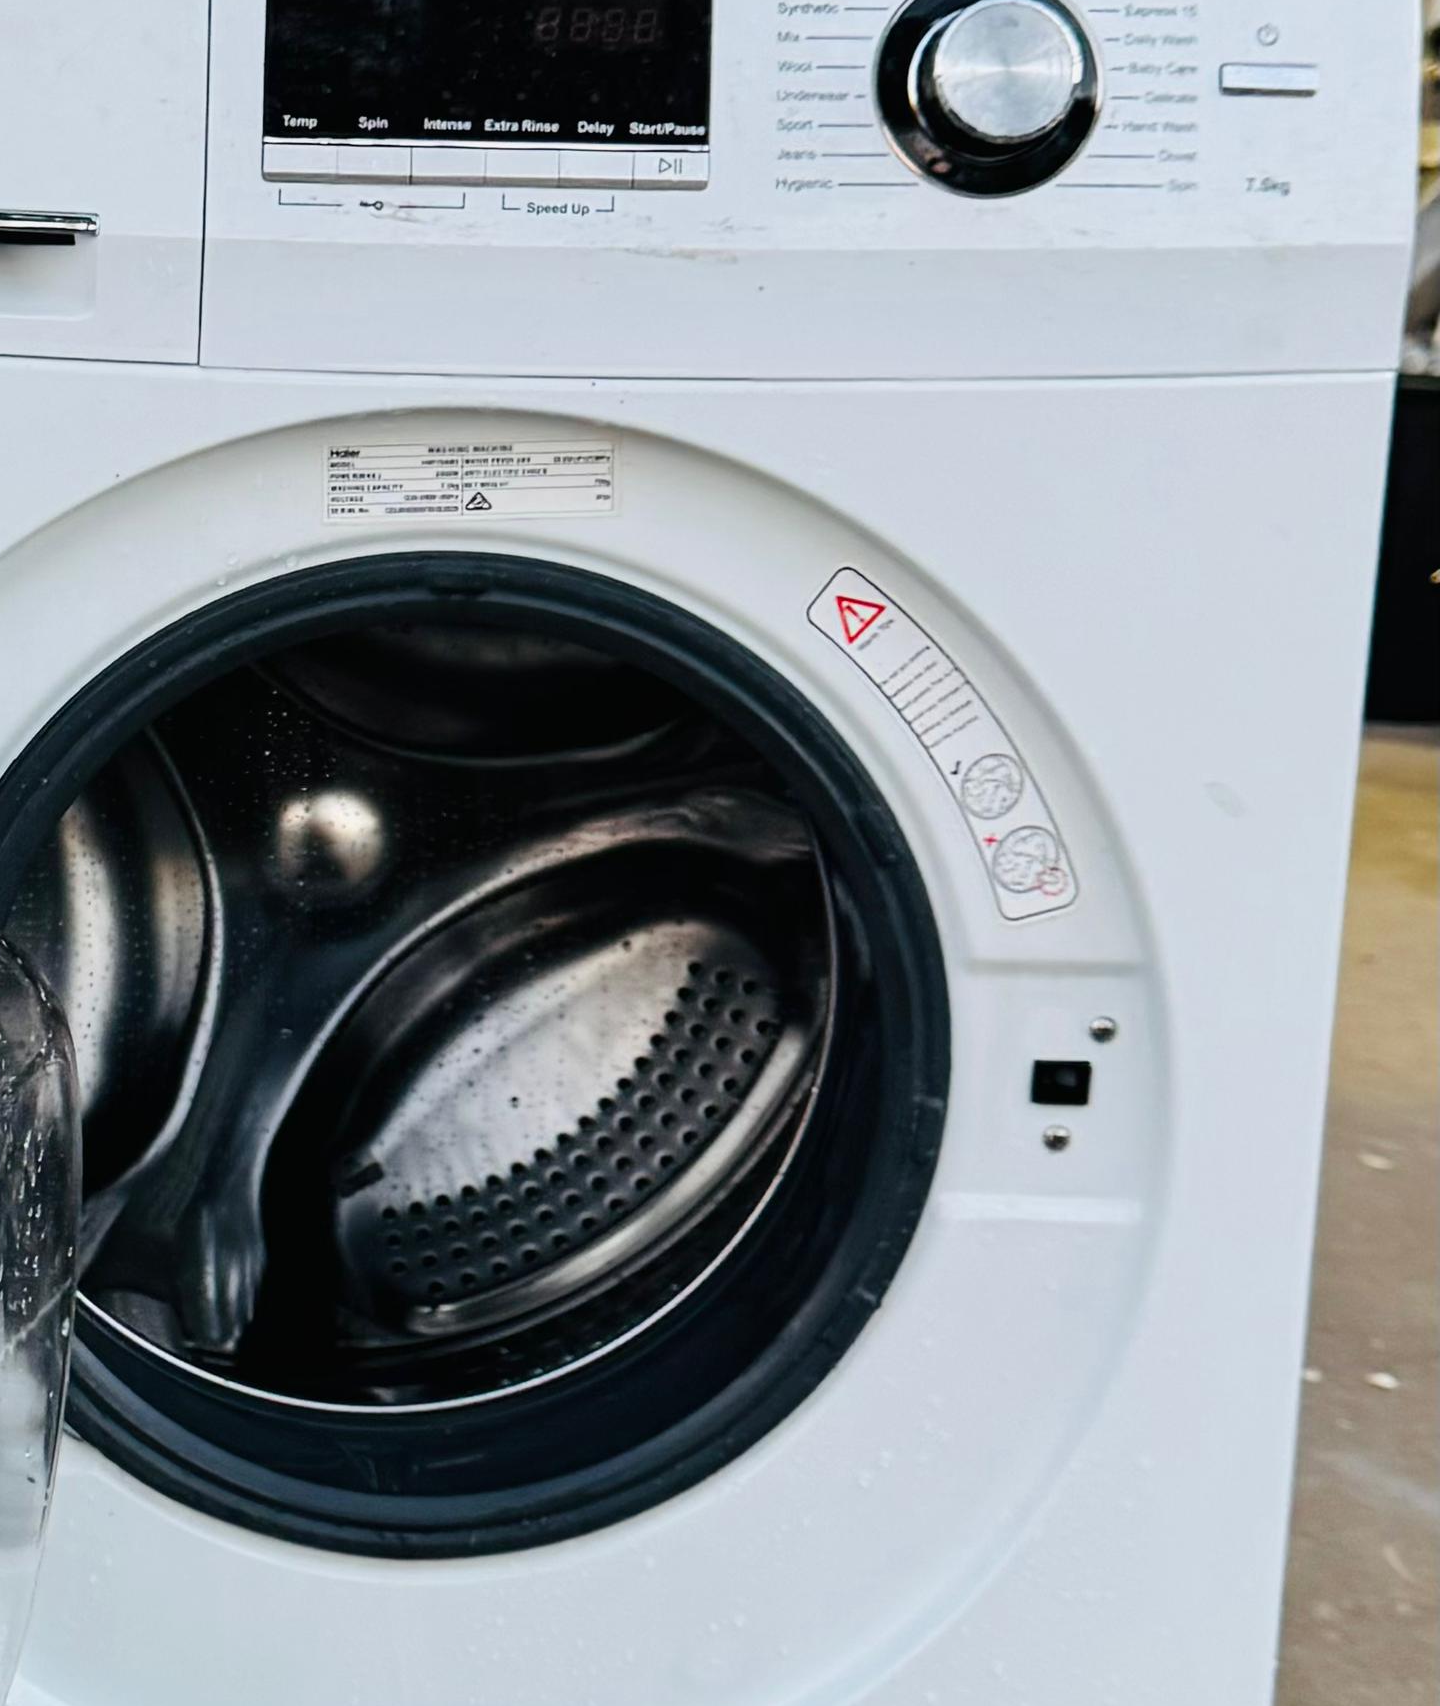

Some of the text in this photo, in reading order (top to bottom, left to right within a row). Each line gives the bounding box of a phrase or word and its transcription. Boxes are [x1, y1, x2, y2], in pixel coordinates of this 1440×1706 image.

[778, 2, 839, 17] Synthetic
[282, 114, 318, 130] Temp
[358, 116, 389, 131] Spin
[423, 117, 472, 132] Intense
[484, 118, 560, 134] Extra Rinse
[577, 120, 615, 137] Delay
[629, 121, 706, 137] Start/Pause
[526, 201, 590, 216] Speed Up
[330, 448, 360, 458] Haier
